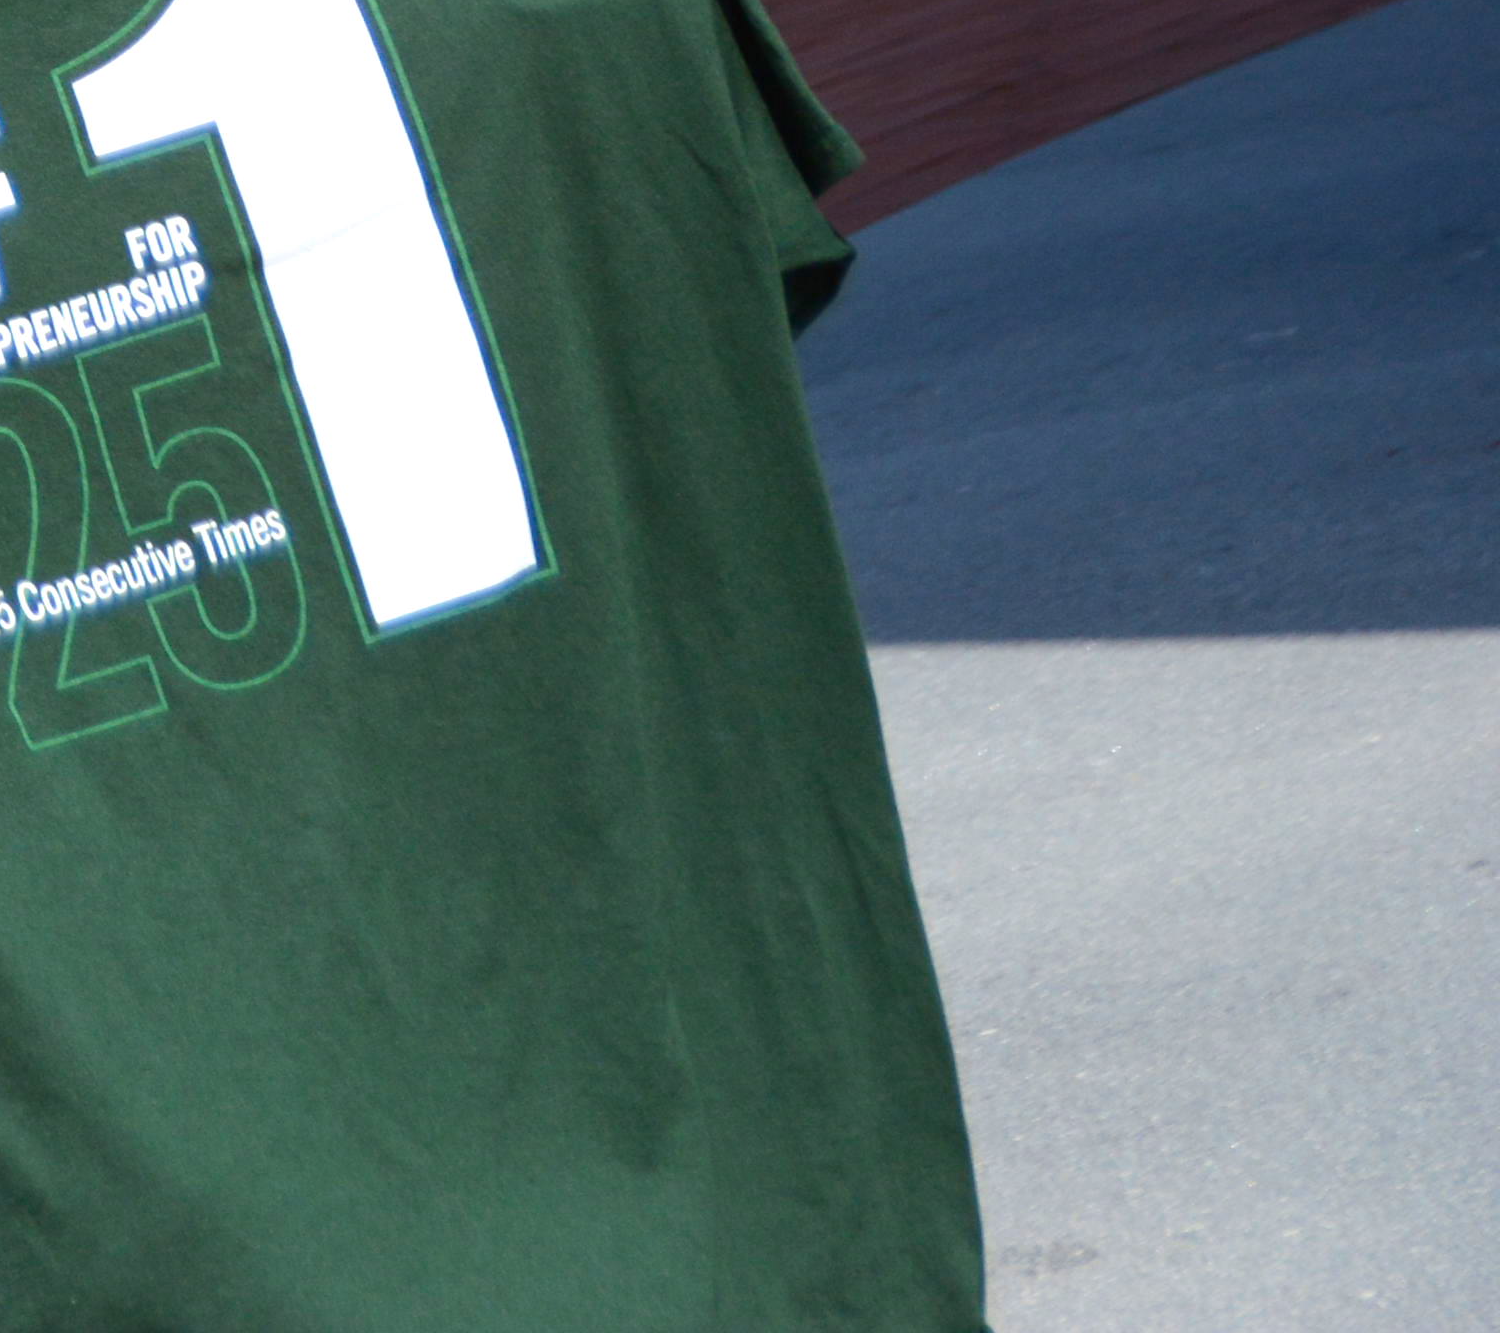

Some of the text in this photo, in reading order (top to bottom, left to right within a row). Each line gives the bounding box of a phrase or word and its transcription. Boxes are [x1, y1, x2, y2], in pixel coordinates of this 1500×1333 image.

[124, 215, 198, 270] FOR
[16, 538, 196, 623] Consecutive
[191, 507, 287, 565] Times
